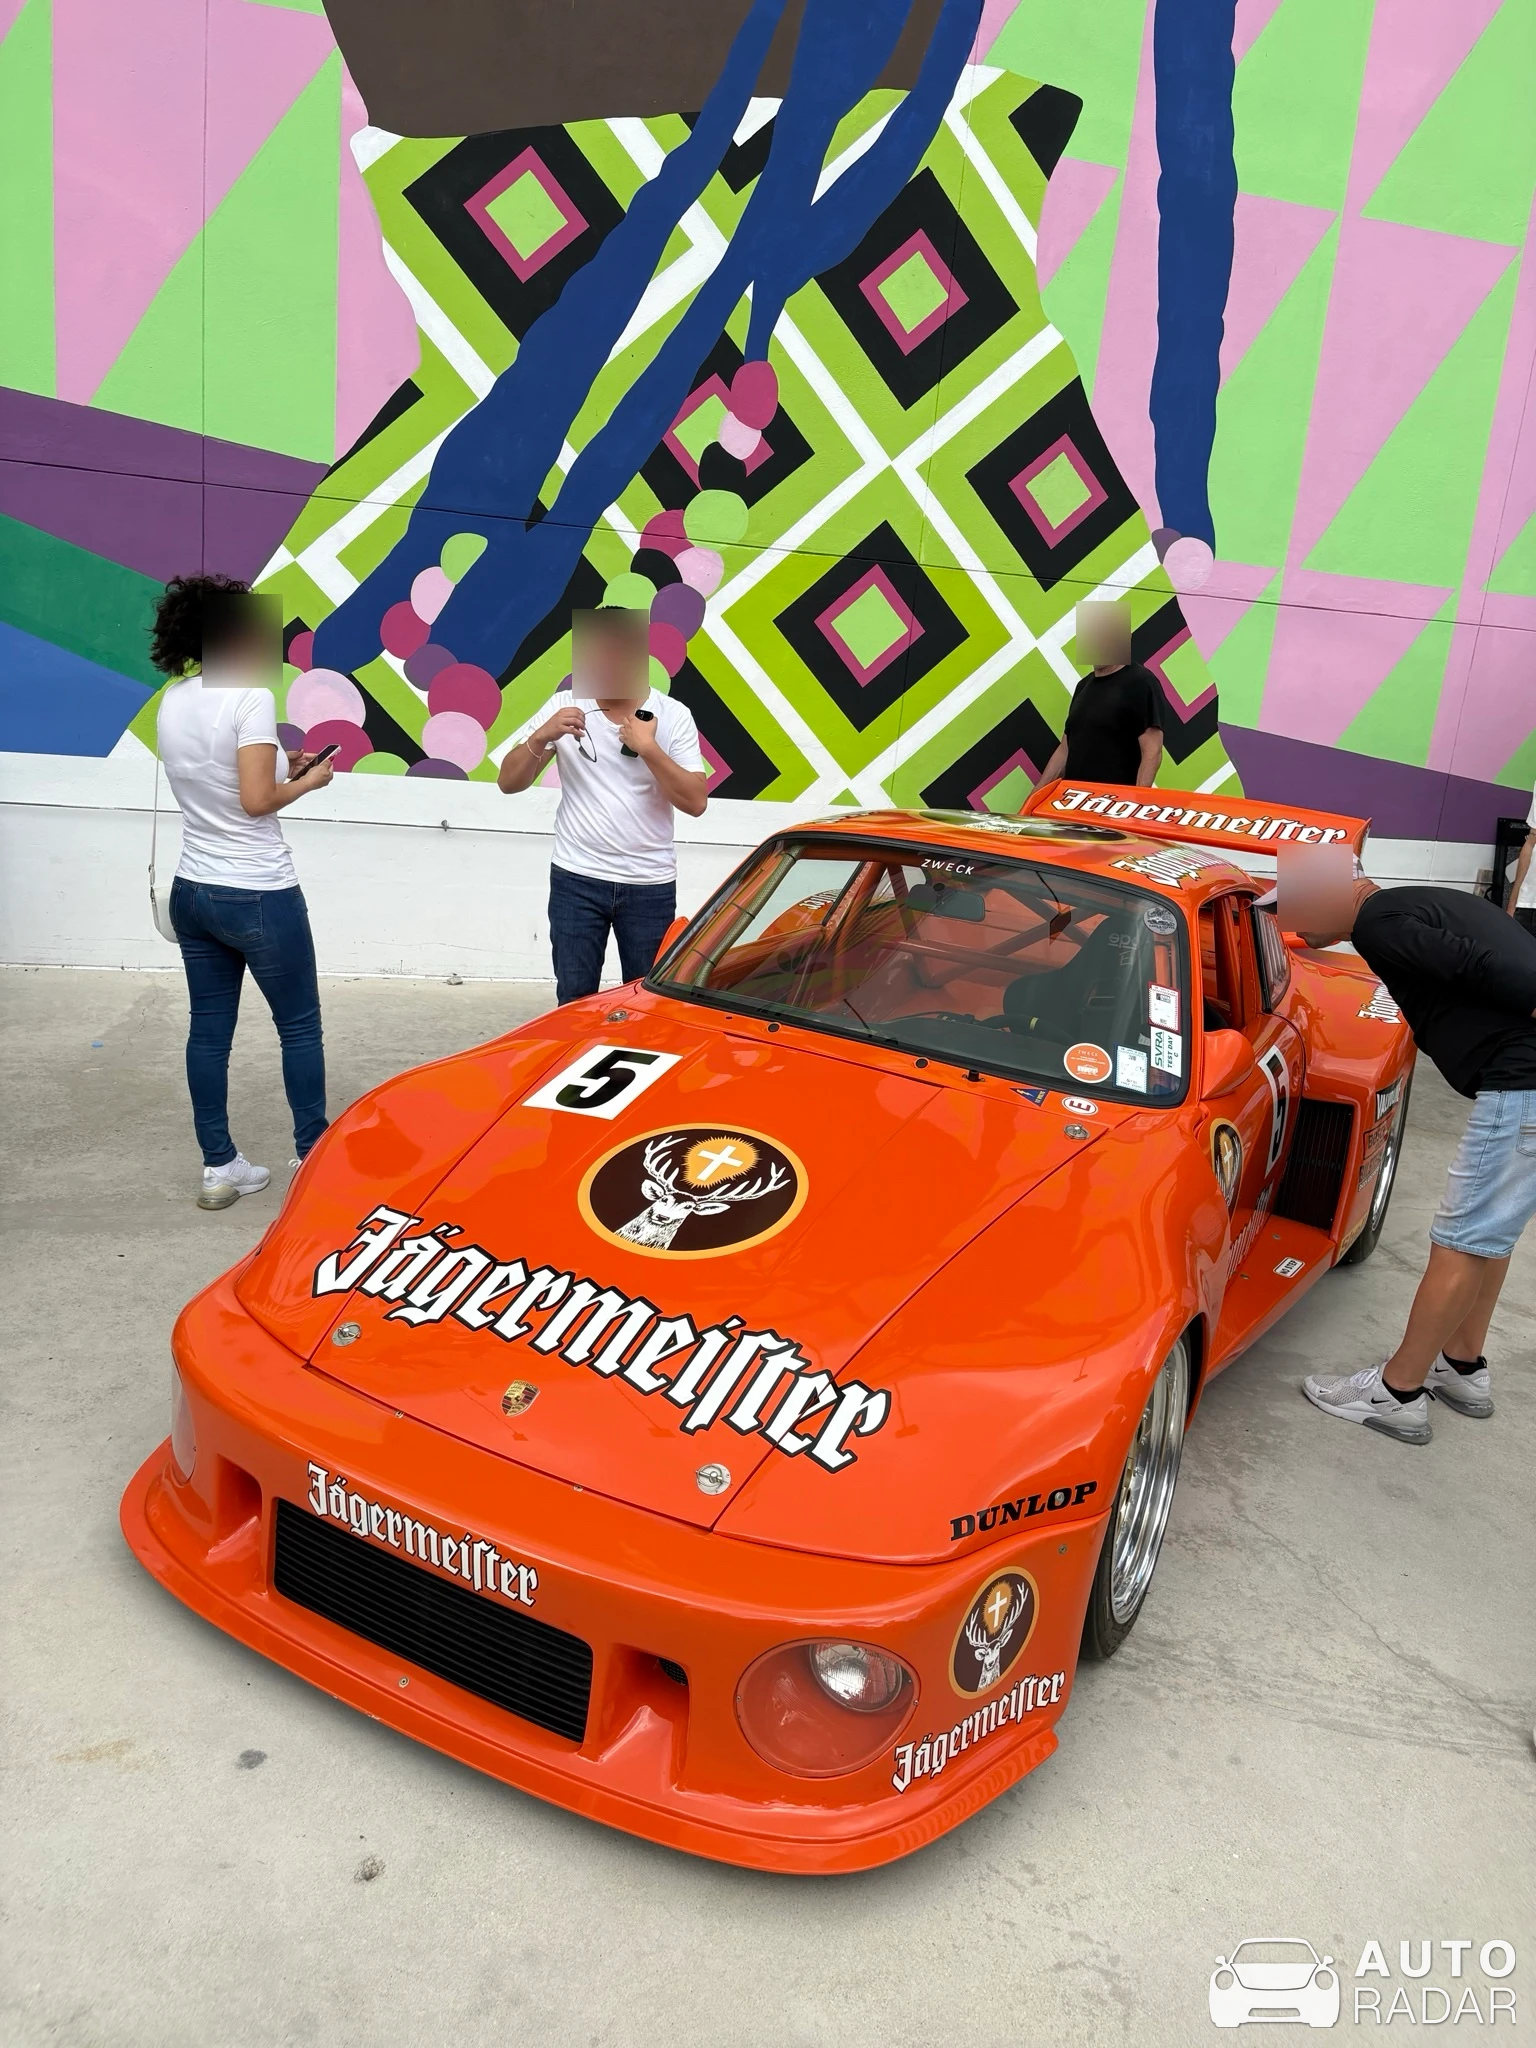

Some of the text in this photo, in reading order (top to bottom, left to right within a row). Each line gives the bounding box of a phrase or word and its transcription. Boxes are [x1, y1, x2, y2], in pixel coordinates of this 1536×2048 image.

[921, 858, 975, 875] ZWECK
[555, 1050, 659, 1108] 5
[1155, 1031, 1163, 1067] SVRA
[1266, 1053, 1286, 1163] 5
[311, 1204, 892, 1472] Jägermeister
[308, 1460, 539, 1607] Jägermeister
[950, 1481, 1097, 1541] DUNLOP
[892, 1671, 1065, 1793] Jägermeister
